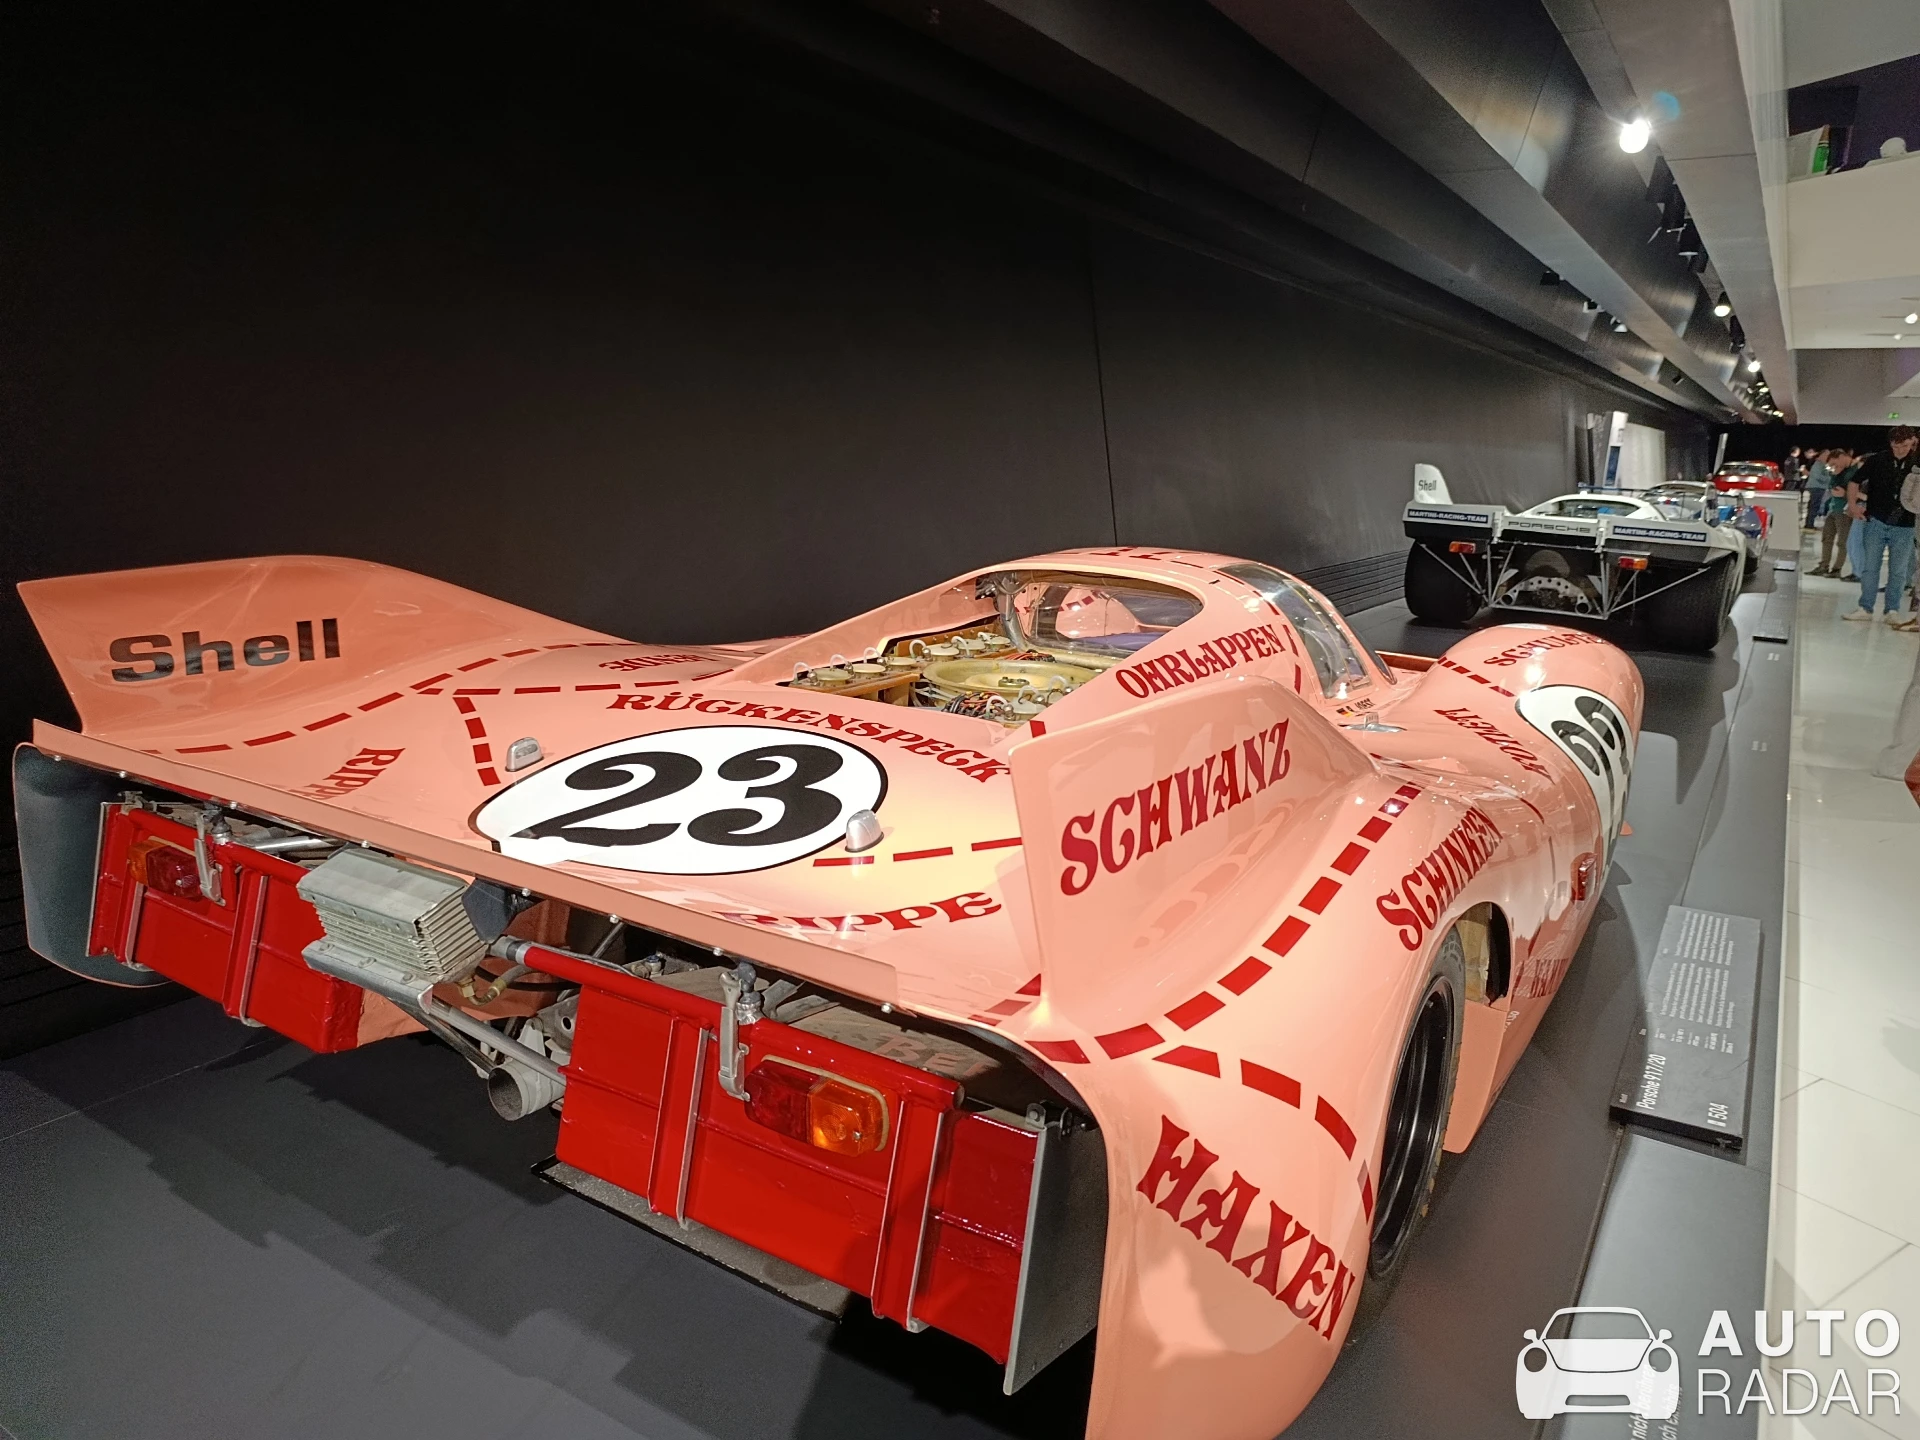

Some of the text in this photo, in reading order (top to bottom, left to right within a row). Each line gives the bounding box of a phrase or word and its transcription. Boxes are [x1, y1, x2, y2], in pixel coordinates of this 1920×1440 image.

[1418, 480, 1437, 491] Shell
[1409, 510, 1487, 523] MARTINI-RACING-TEAM
[1508, 521, 1591, 533] PORSCHE
[1614, 526, 1706, 541] MARTINI-RACING-TEAM
[109, 617, 341, 682] Shell
[1115, 623, 1289, 698] OHRLAPPEN
[605, 691, 1011, 783] RÜCKENSPECK
[509, 743, 844, 848] 23
[1059, 717, 1292, 896] SCHWANZ
[1375, 805, 1504, 951] SCHINKEN
[711, 891, 1003, 932] RIPPE
[1636, 1053, 1667, 1110] Porsche 917/20
[1707, 1102, 1728, 1120] 504
[1135, 1114, 1356, 1341] HAXEN
